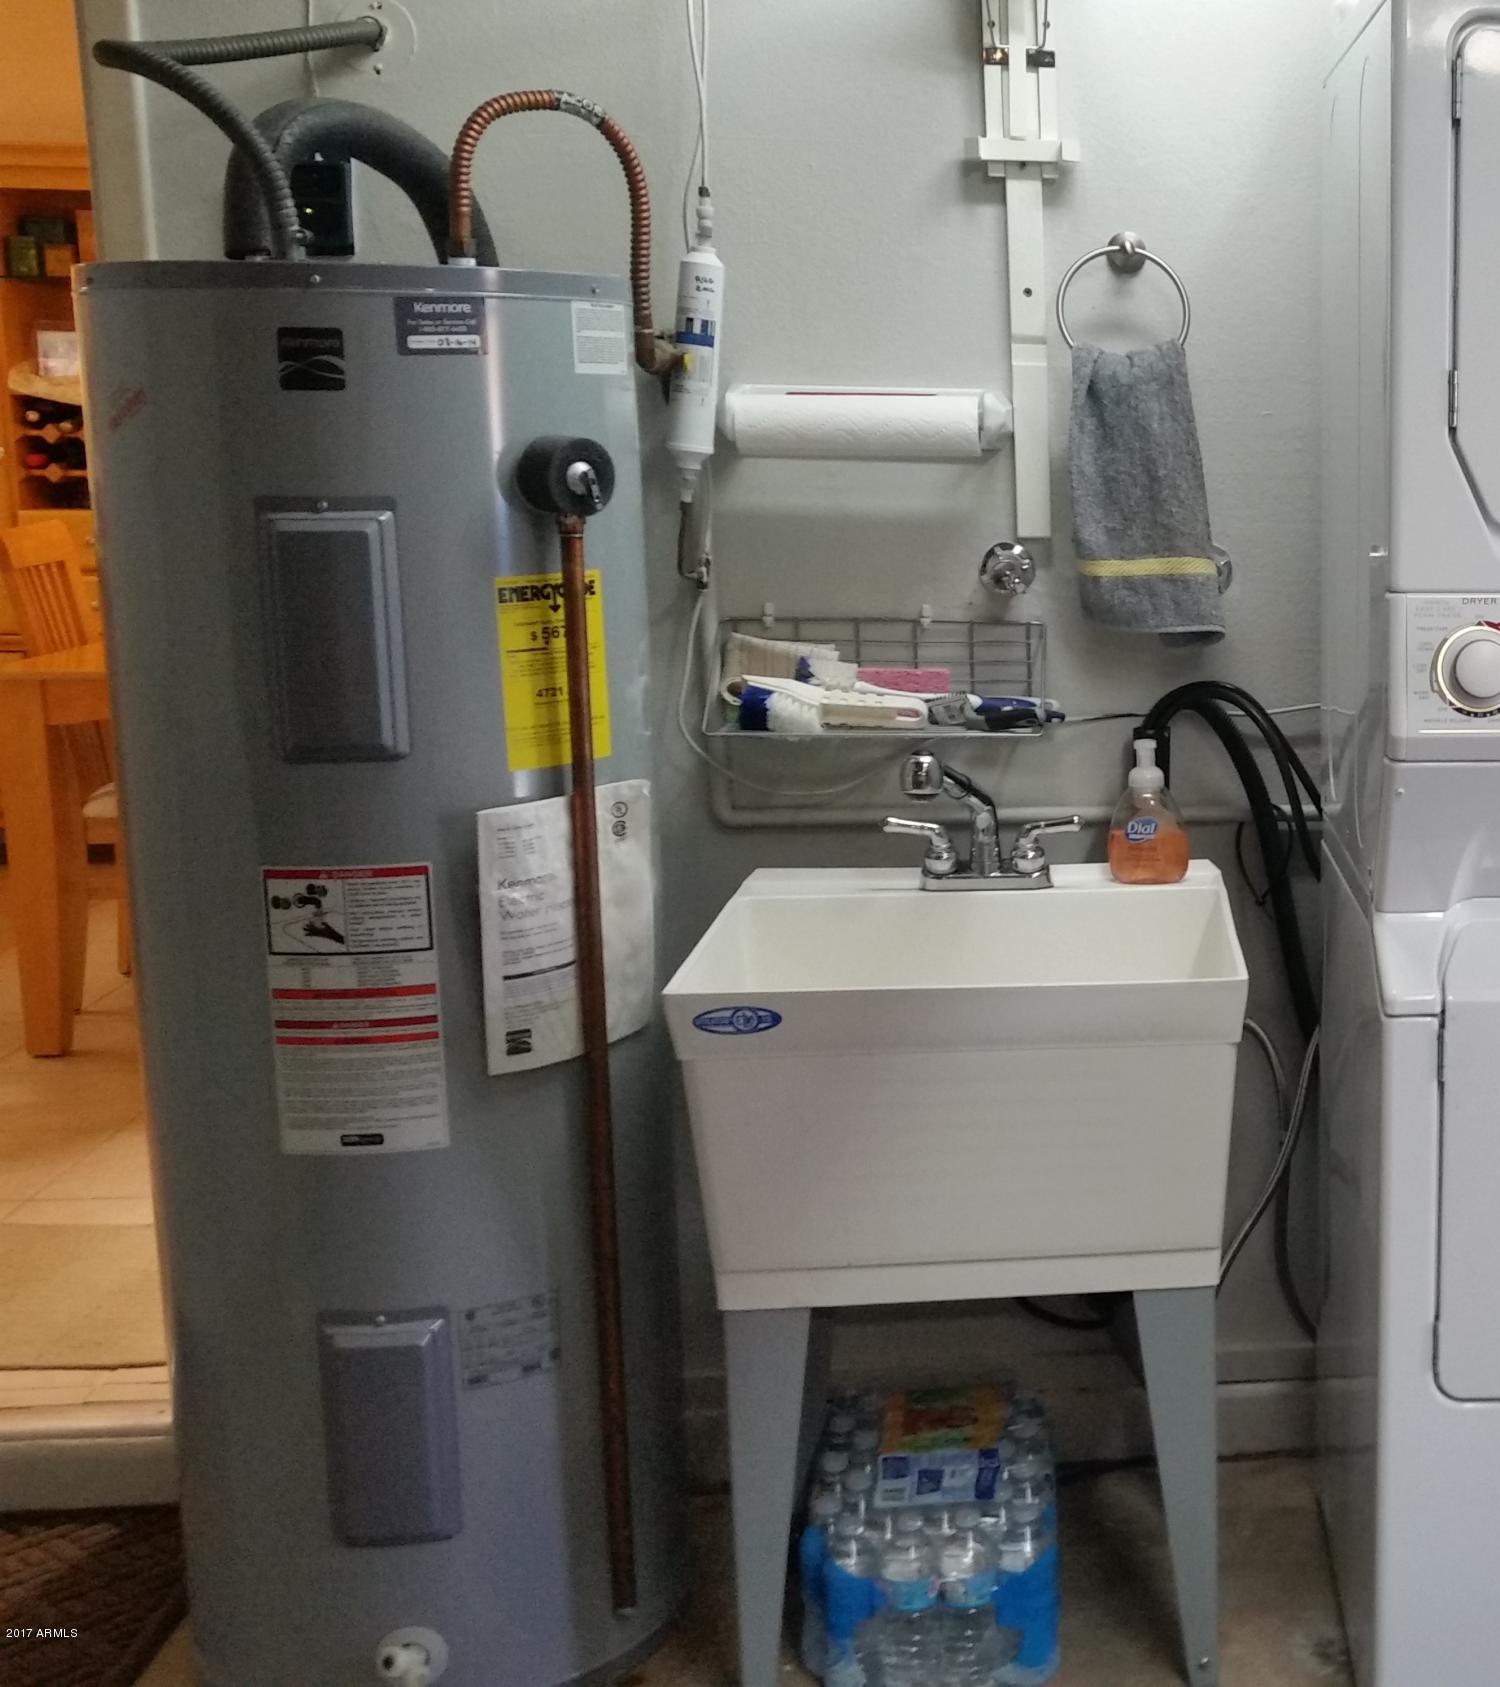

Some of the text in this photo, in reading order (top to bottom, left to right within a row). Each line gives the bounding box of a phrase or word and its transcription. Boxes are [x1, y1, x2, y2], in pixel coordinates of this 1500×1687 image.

[414, 303, 472, 313] Kenmore
[1462, 597, 1497, 605] DRYER
[1127, 822, 1156, 834] Dial
